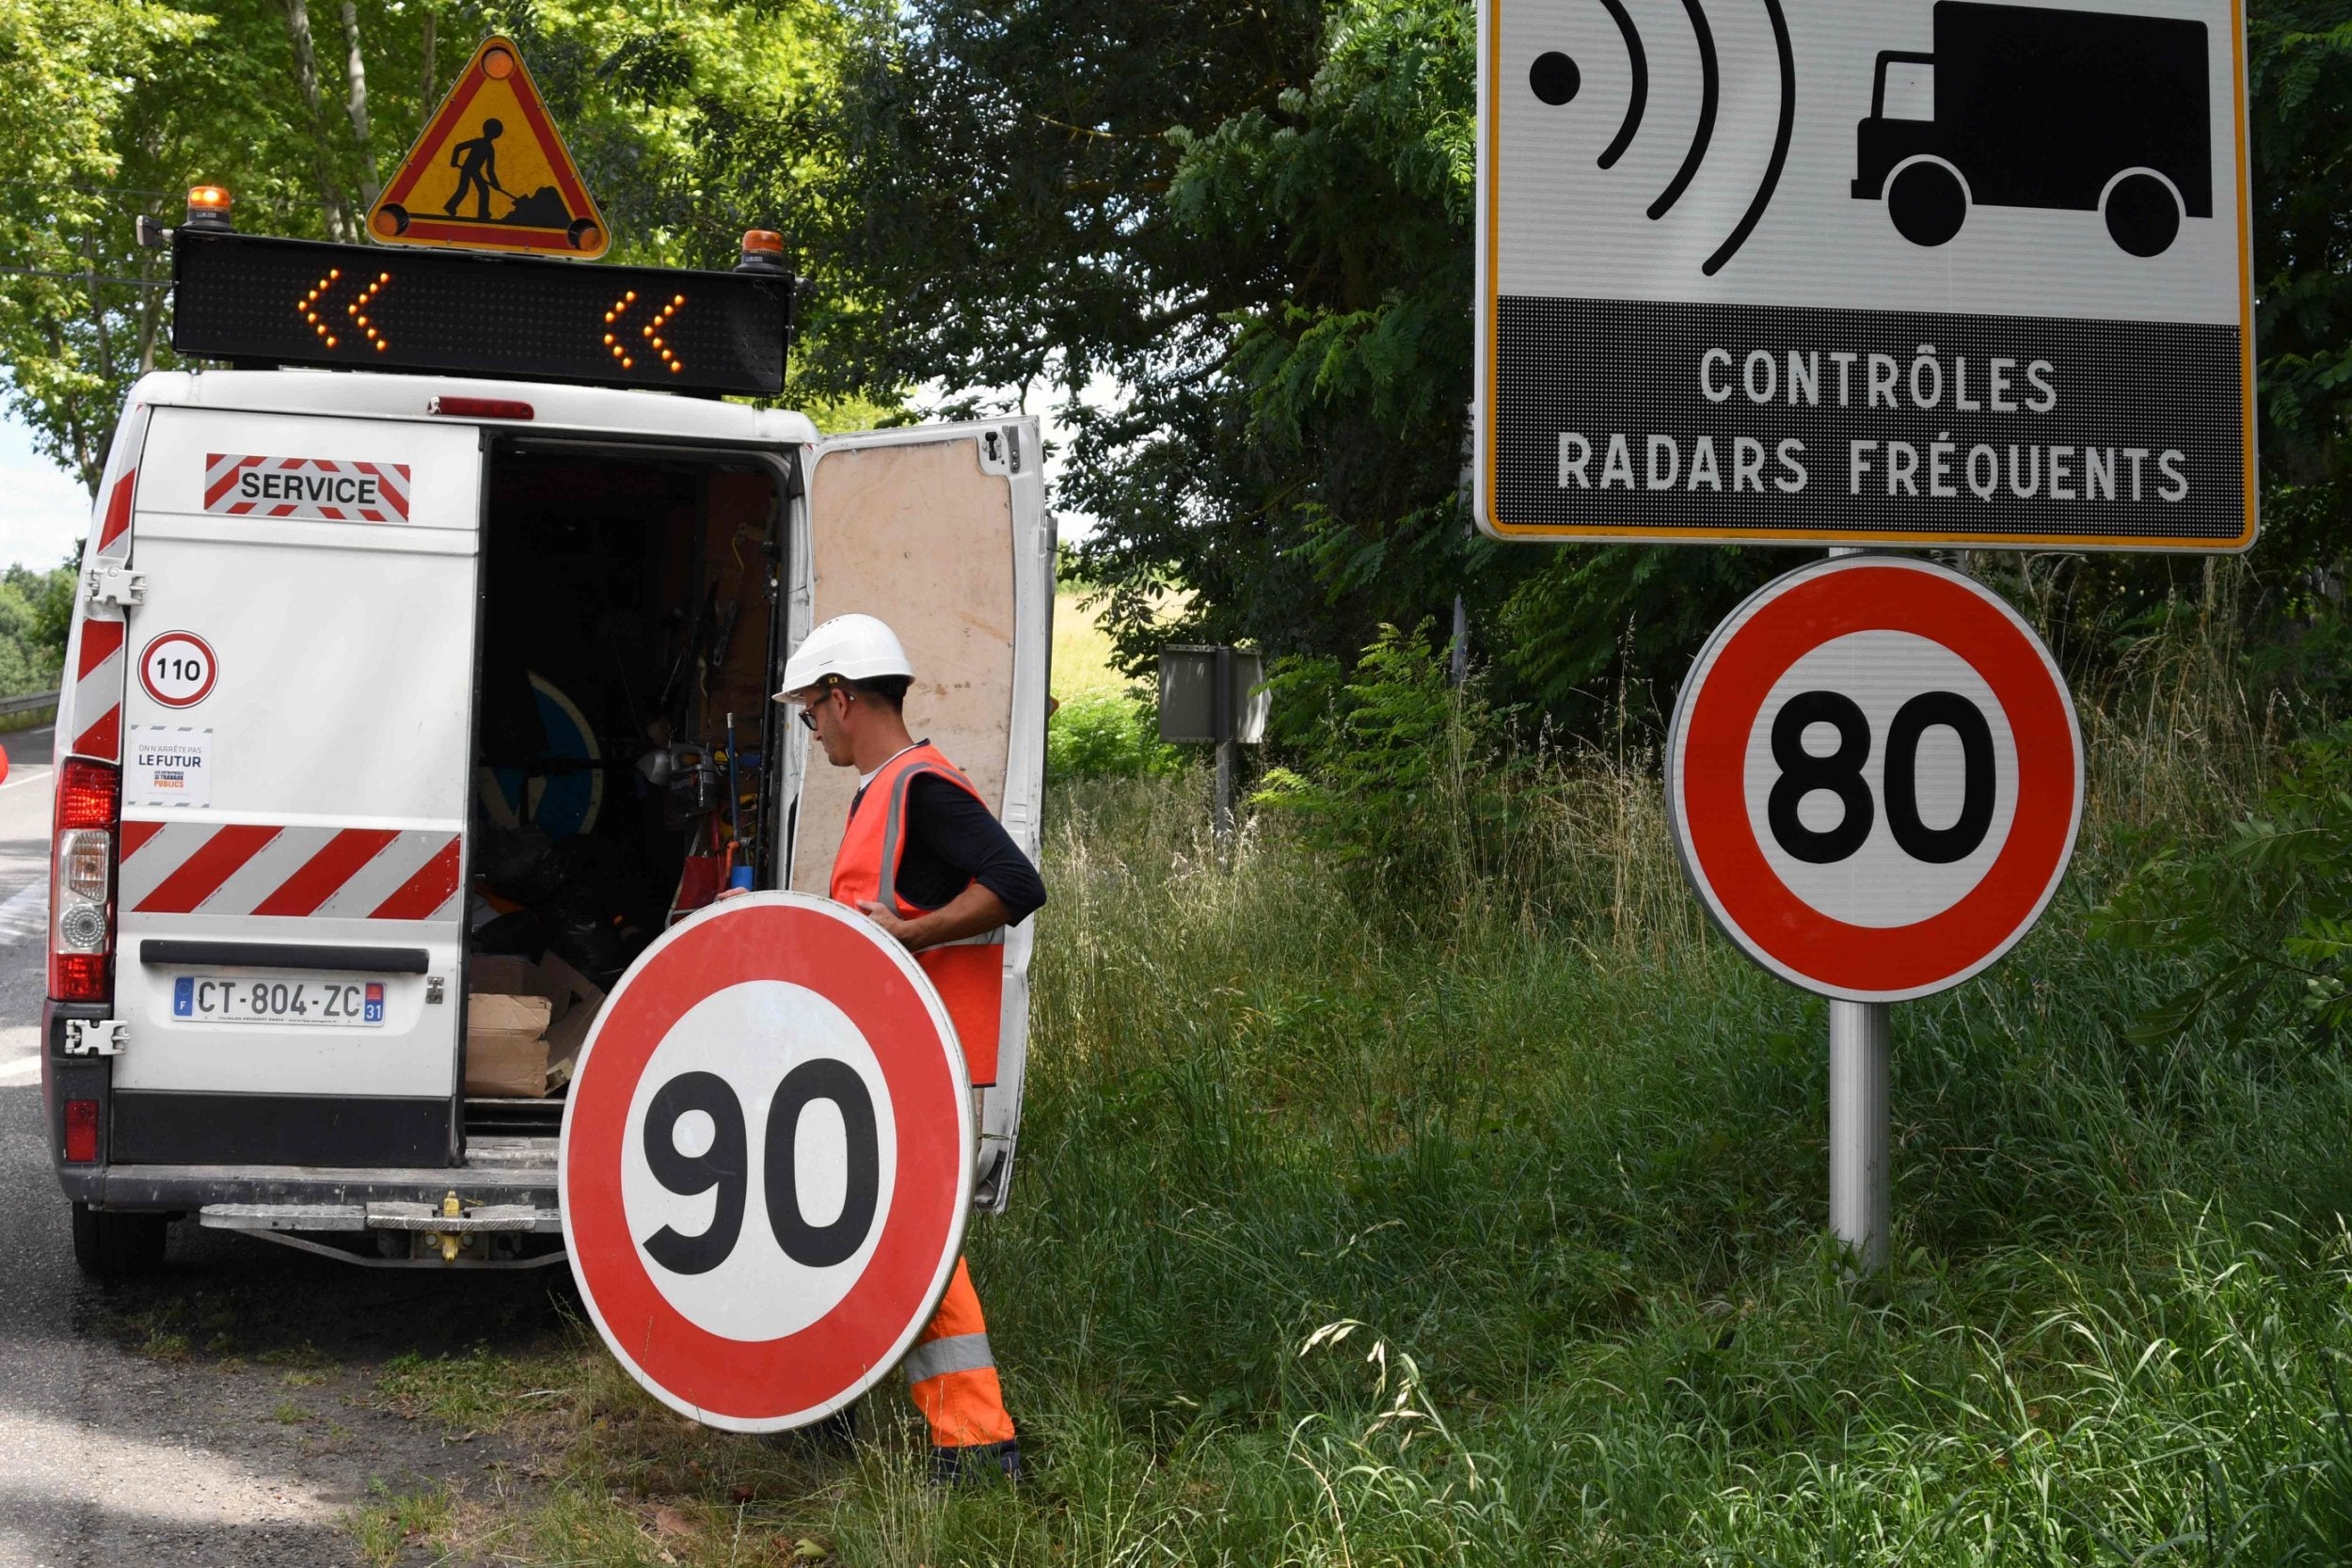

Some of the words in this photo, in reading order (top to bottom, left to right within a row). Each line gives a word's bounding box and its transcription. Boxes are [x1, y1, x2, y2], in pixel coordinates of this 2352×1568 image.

[1699, 344, 2059, 414] CONTRÔLES
[1557, 431, 1809, 495] RADARS
[1850, 431, 2190, 504] FRÉQUENTS
[241, 472, 376, 504] SERVICE
[157, 657, 200, 681] 110
[138, 754, 154, 766] LE
[156, 755, 201, 768] FUTUR
[1767, 689, 1996, 864] 80
[153, 780, 184, 788] PUBLICS
[180, 1000, 187, 1010] F
[198, 981, 361, 1017] CT-804-ZC
[366, 1004, 382, 1020] 31
[643, 1057, 880, 1275] 90
